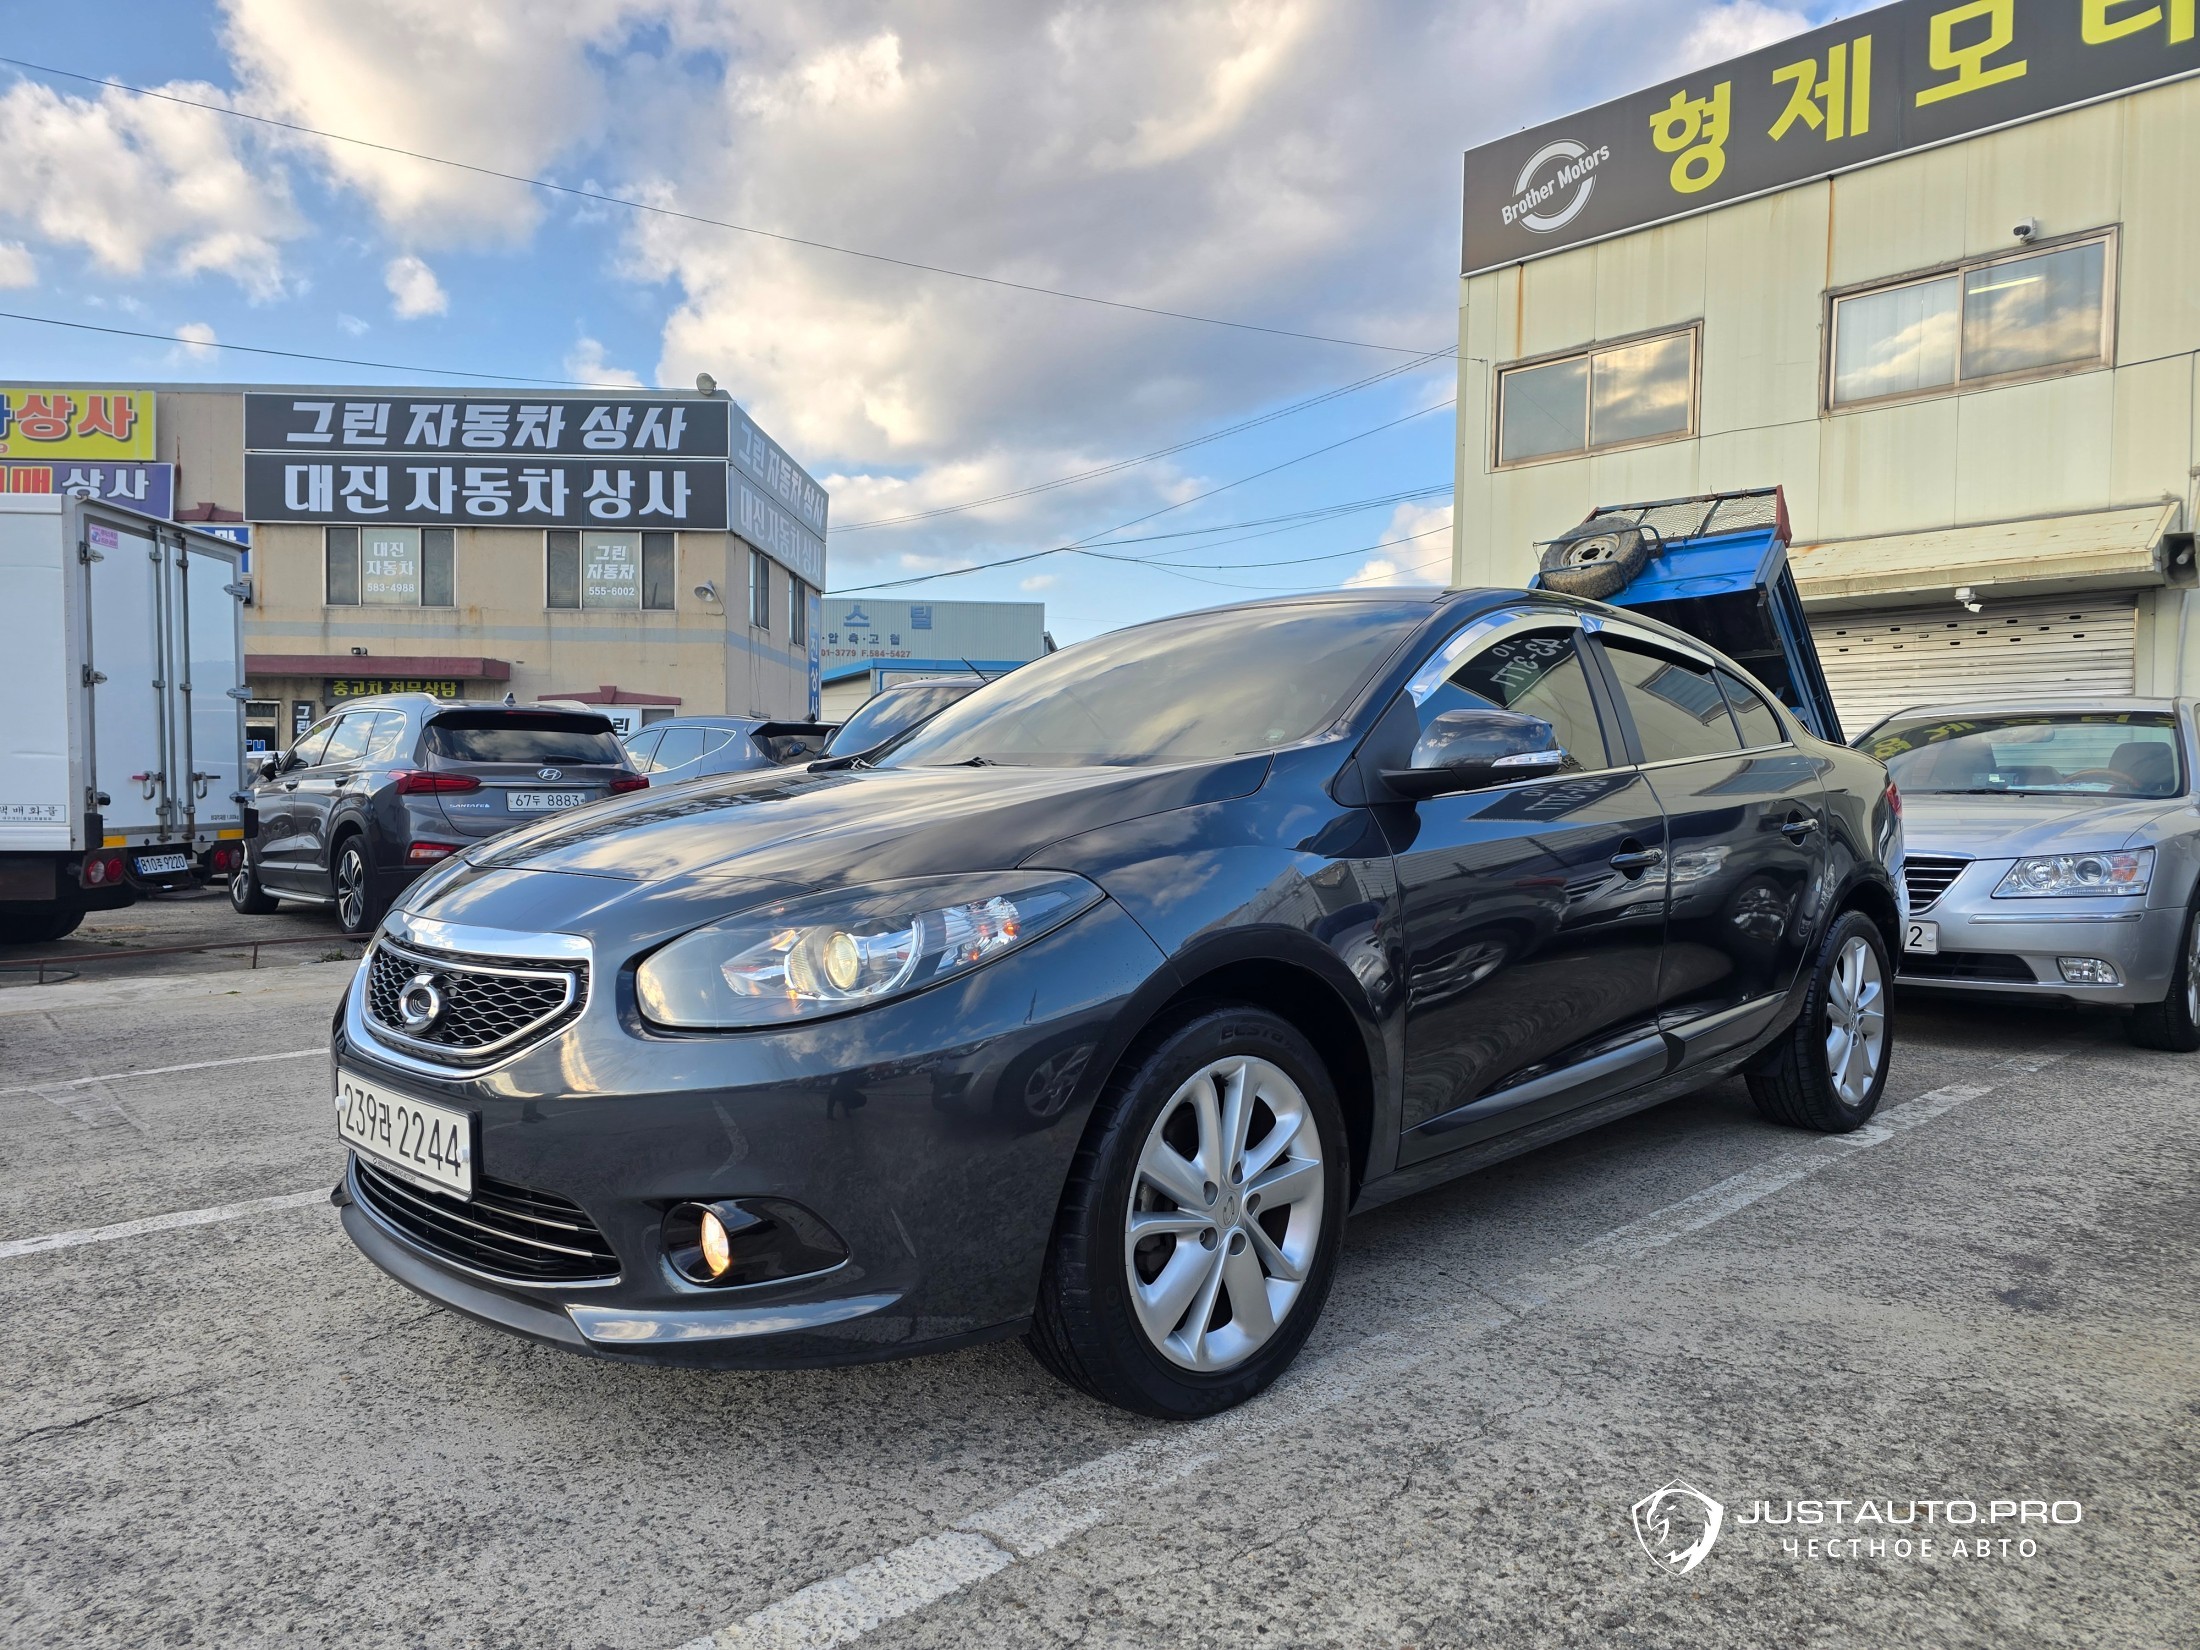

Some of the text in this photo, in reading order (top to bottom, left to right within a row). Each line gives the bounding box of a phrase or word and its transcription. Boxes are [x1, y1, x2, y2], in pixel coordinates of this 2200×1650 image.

[1501, 145, 1610, 225] Brother Motors
[286, 401, 688, 451] 그린 자동차 상사
[0, 466, 149, 500] 매 상사
[738, 421, 824, 529] 그린 자동차 상사
[284, 464, 691, 519] 대진 자동차 상사
[740, 484, 821, 582] 대진 자동차 상사
[373, 541, 404, 557] 대진
[595, 545, 627, 560] 그린
[365, 560, 415, 576] 자동차
[586, 563, 635, 579] 자동차
[367, 583, 415, 592] 583-4988
[588, 586, 635, 596] 555-6002
[333, 680, 384, 696] 중고차
[515, 794, 580, 806] 67두 8883
[140, 855, 185, 871] 810주 9220
[1909, 925, 1924, 948] 2
[344, 1083, 461, 1177] 239라 2244
